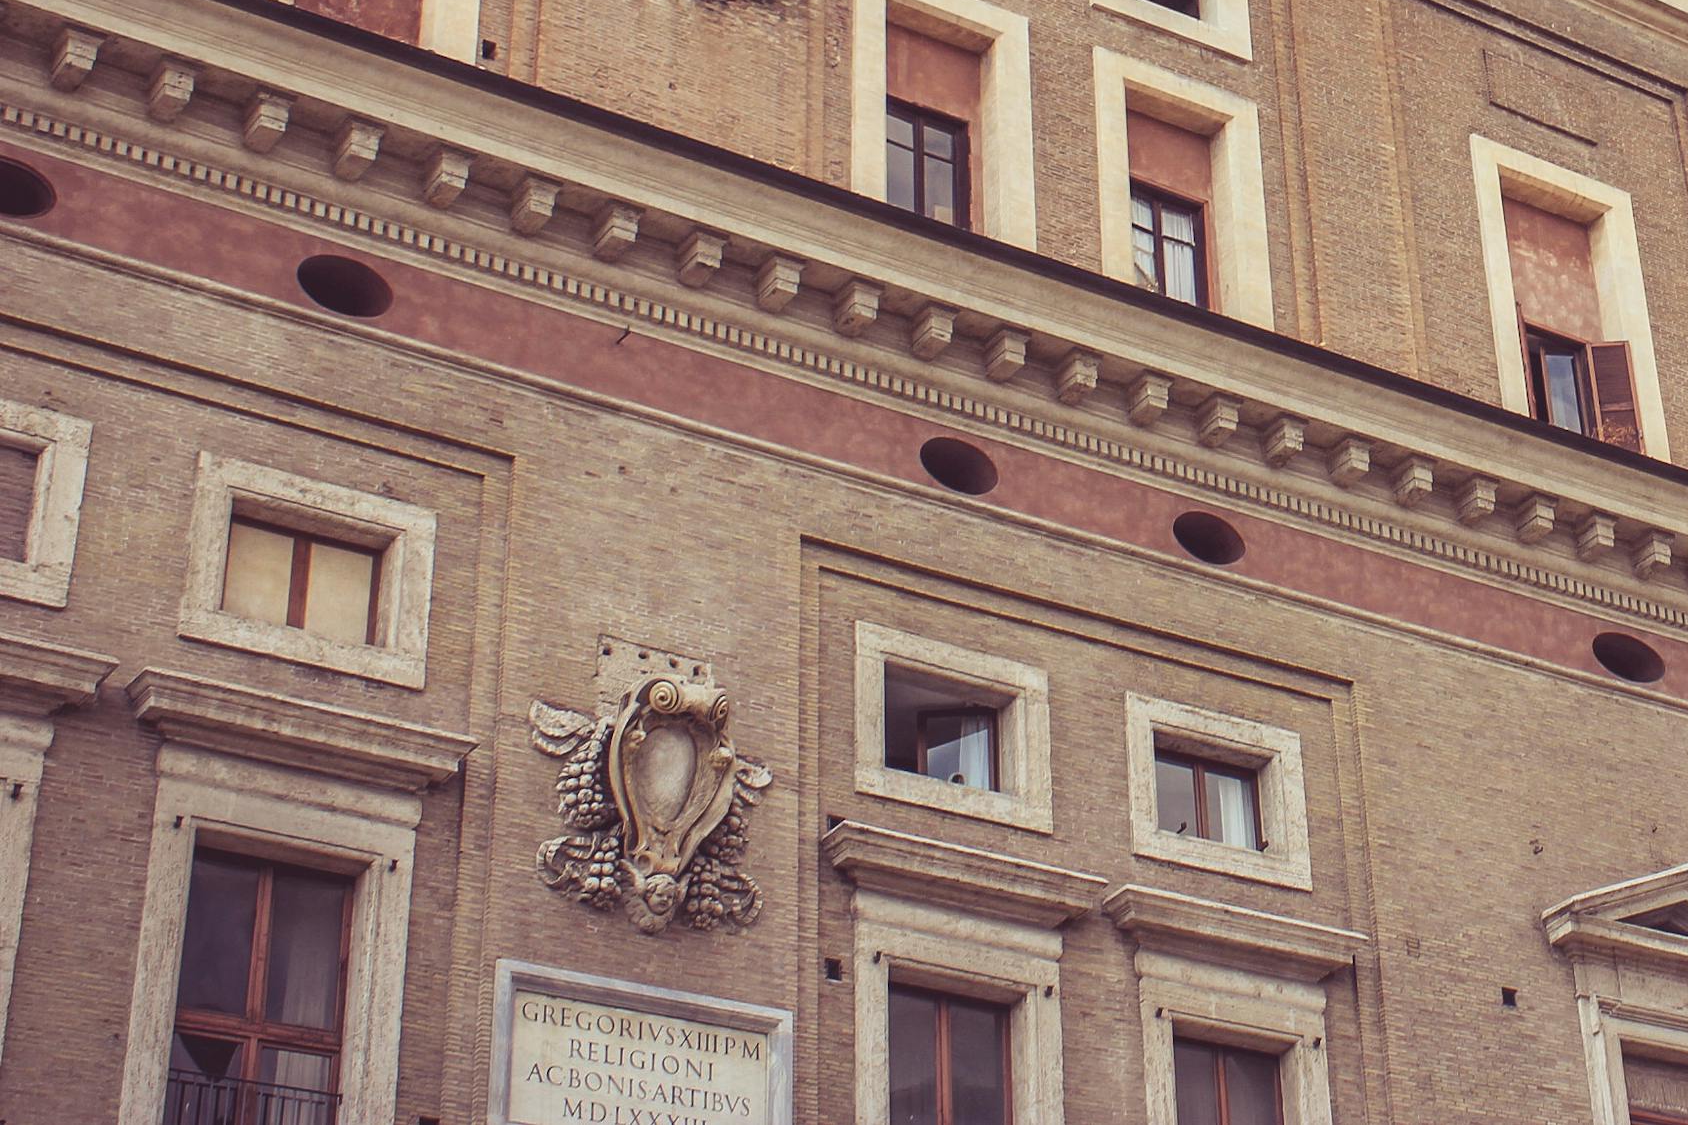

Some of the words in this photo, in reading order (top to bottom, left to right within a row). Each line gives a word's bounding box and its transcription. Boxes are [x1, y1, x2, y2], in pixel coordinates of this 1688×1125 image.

[521, 1000, 675, 1046] GREGORIVS
[568, 1037, 713, 1082] RELIGIONI
[651, 1082, 751, 1117] ARTIBVS
